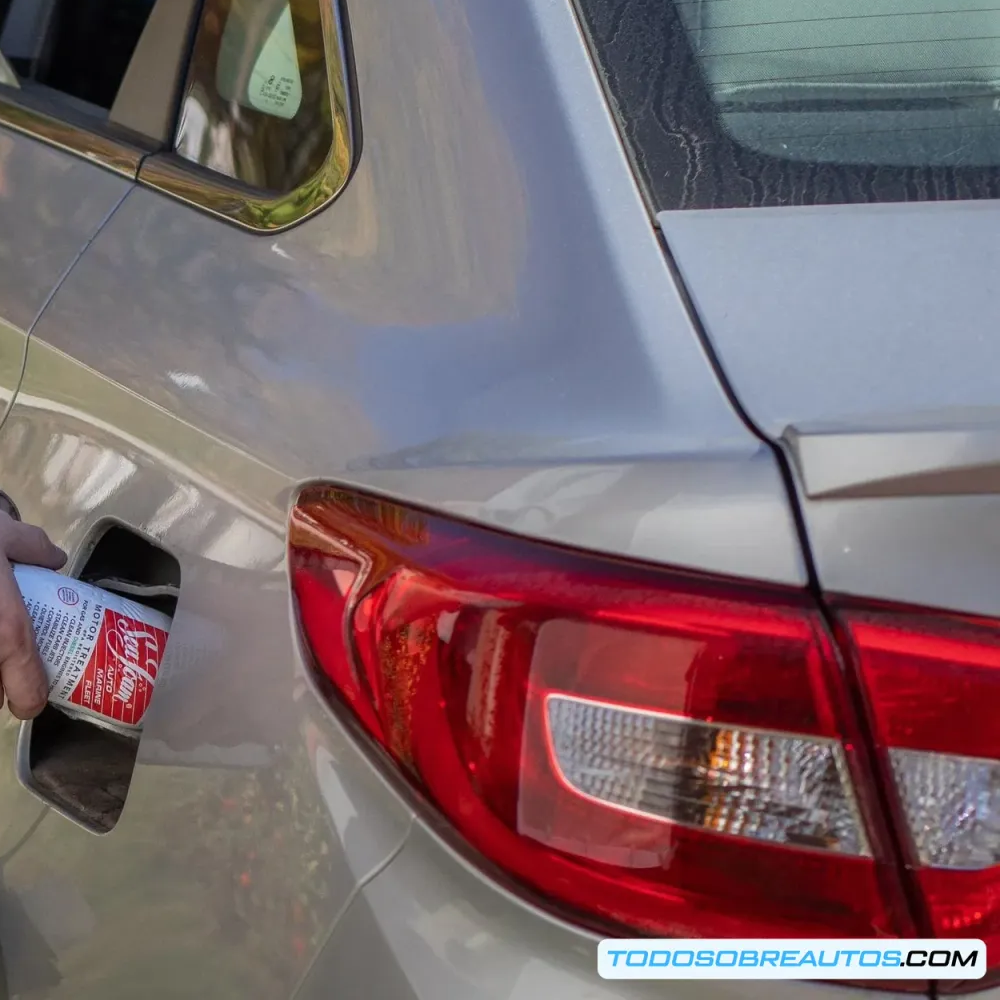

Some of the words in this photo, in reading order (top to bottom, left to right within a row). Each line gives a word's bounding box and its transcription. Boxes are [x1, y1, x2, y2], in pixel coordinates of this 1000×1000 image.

[37, 607, 47, 624] QUIET
[41, 610, 54, 636] CONTROL
[49, 613, 62, 638] STABILIZE
[58, 616, 69, 635] CLEAN
[87, 604, 102, 641] MOTOR
[66, 619, 76, 637] CLEAN
[41, 639, 52, 656] FUELS
[52, 635, 62, 650] CARB
[53, 637, 70, 667] INJECTORS
[67, 636, 78, 655] DIESEL
[47, 650, 56, 663] JETS
[56, 656, 70, 679] ENGINES
[58, 647, 91, 700] TREATMENT
[106, 666, 114, 693] AUTO
[84, 679, 92, 704] FLEET
[94, 668, 103, 705] MARINE
